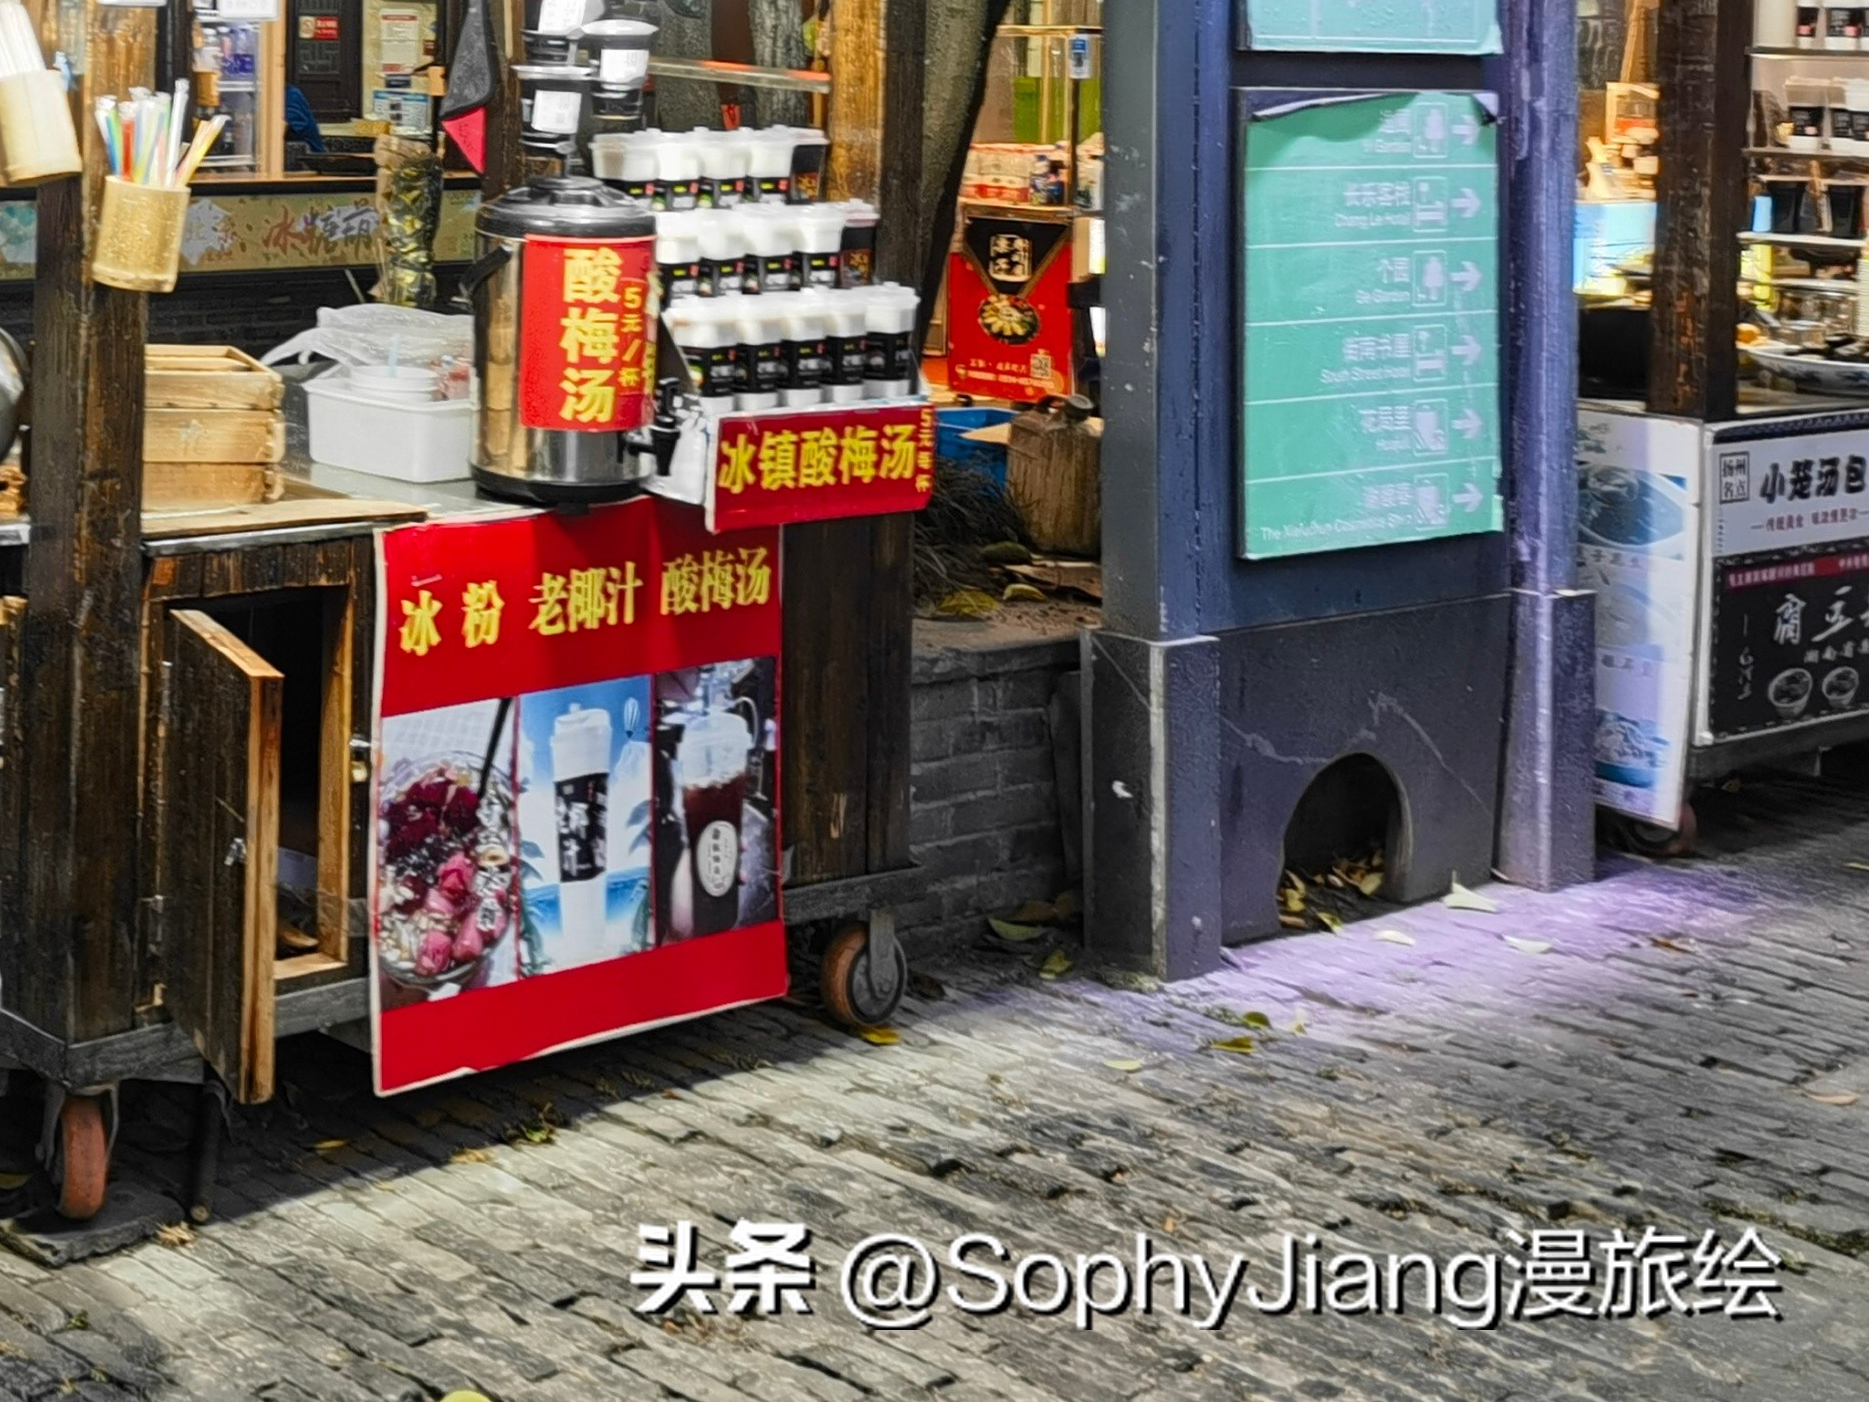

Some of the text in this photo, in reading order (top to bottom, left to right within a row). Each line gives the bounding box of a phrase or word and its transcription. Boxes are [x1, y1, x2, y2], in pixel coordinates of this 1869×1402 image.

[558, 247, 624, 424] 酸梅汤
[617, 286, 643, 388] 5元/杯
[718, 424, 918, 494] 冰镇酸梅汤
[1759, 454, 1868, 504] 小笼汤包
[398, 547, 772, 657] 冰粉 老椰汁 酸梅汤
